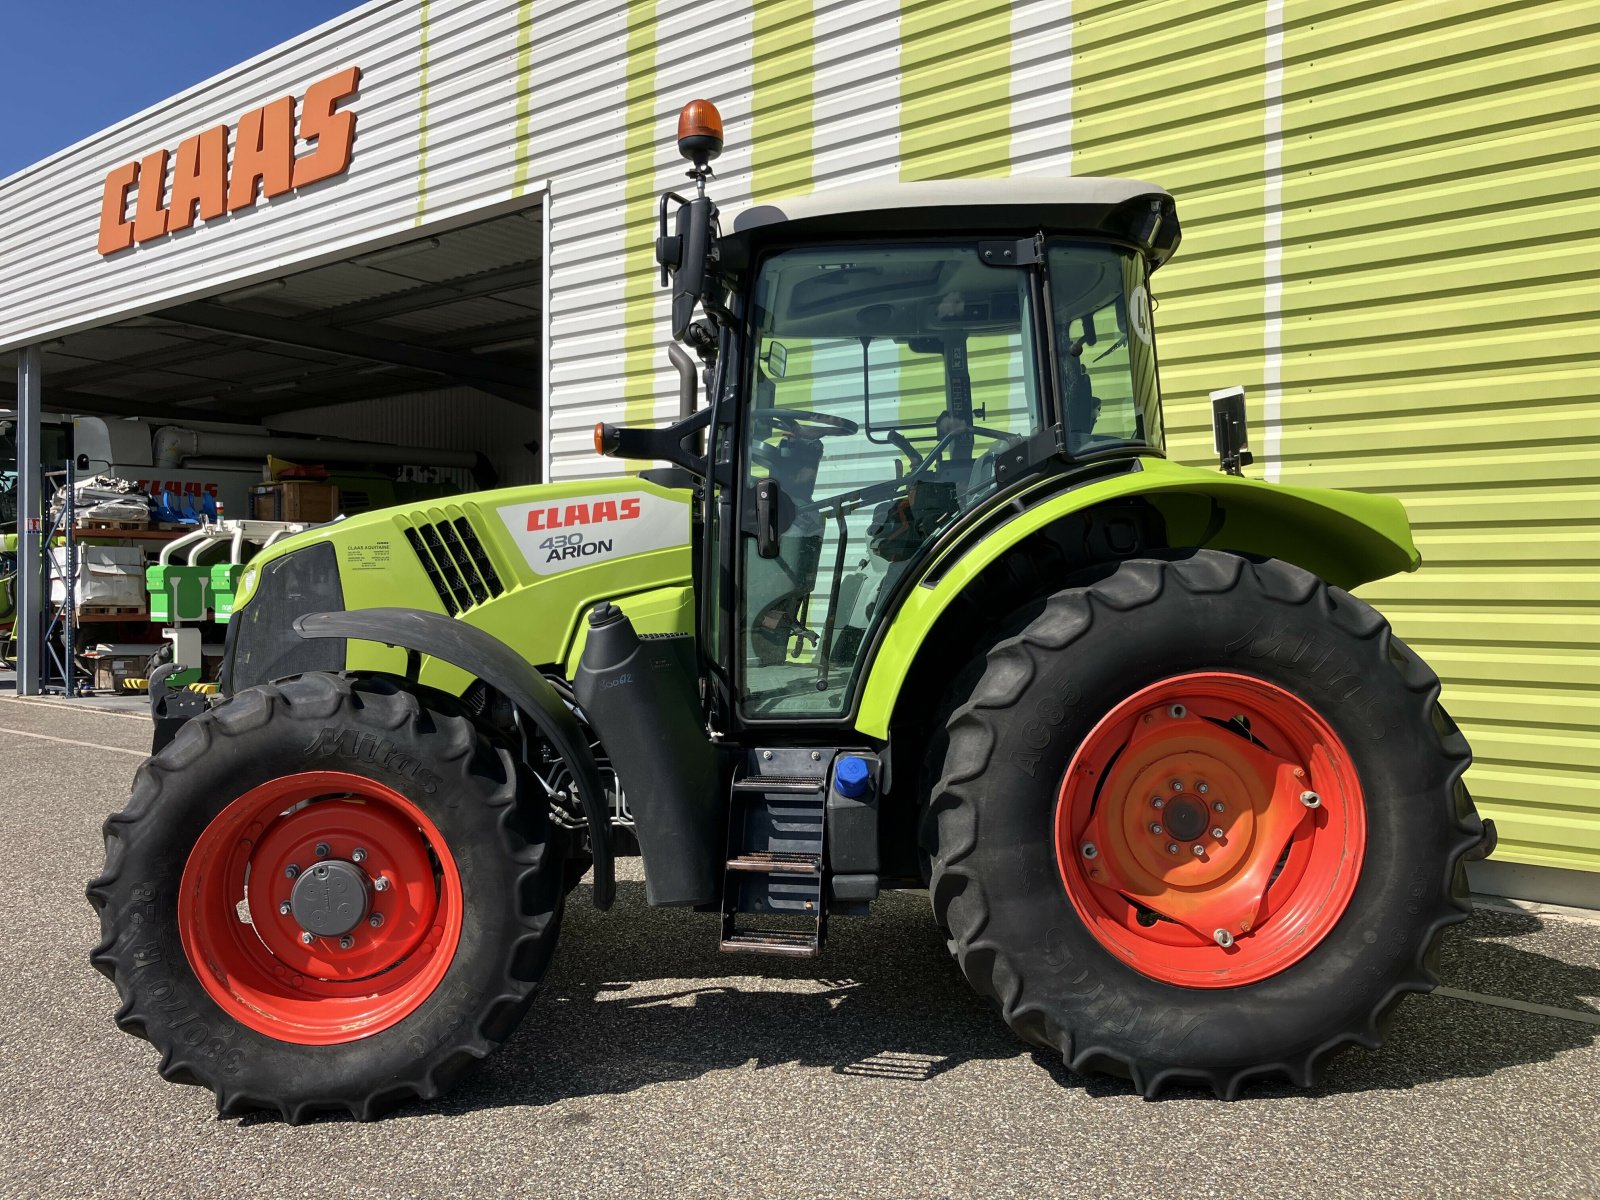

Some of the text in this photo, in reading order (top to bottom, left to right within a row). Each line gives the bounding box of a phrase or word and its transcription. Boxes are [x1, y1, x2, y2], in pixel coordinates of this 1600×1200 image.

[98, 66, 360, 256] CLAAS
[527, 498, 640, 532] CLAAS
[539, 532, 583, 550] 430
[546, 539, 613, 563] ARION
[304, 727, 444, 794] Mitas
